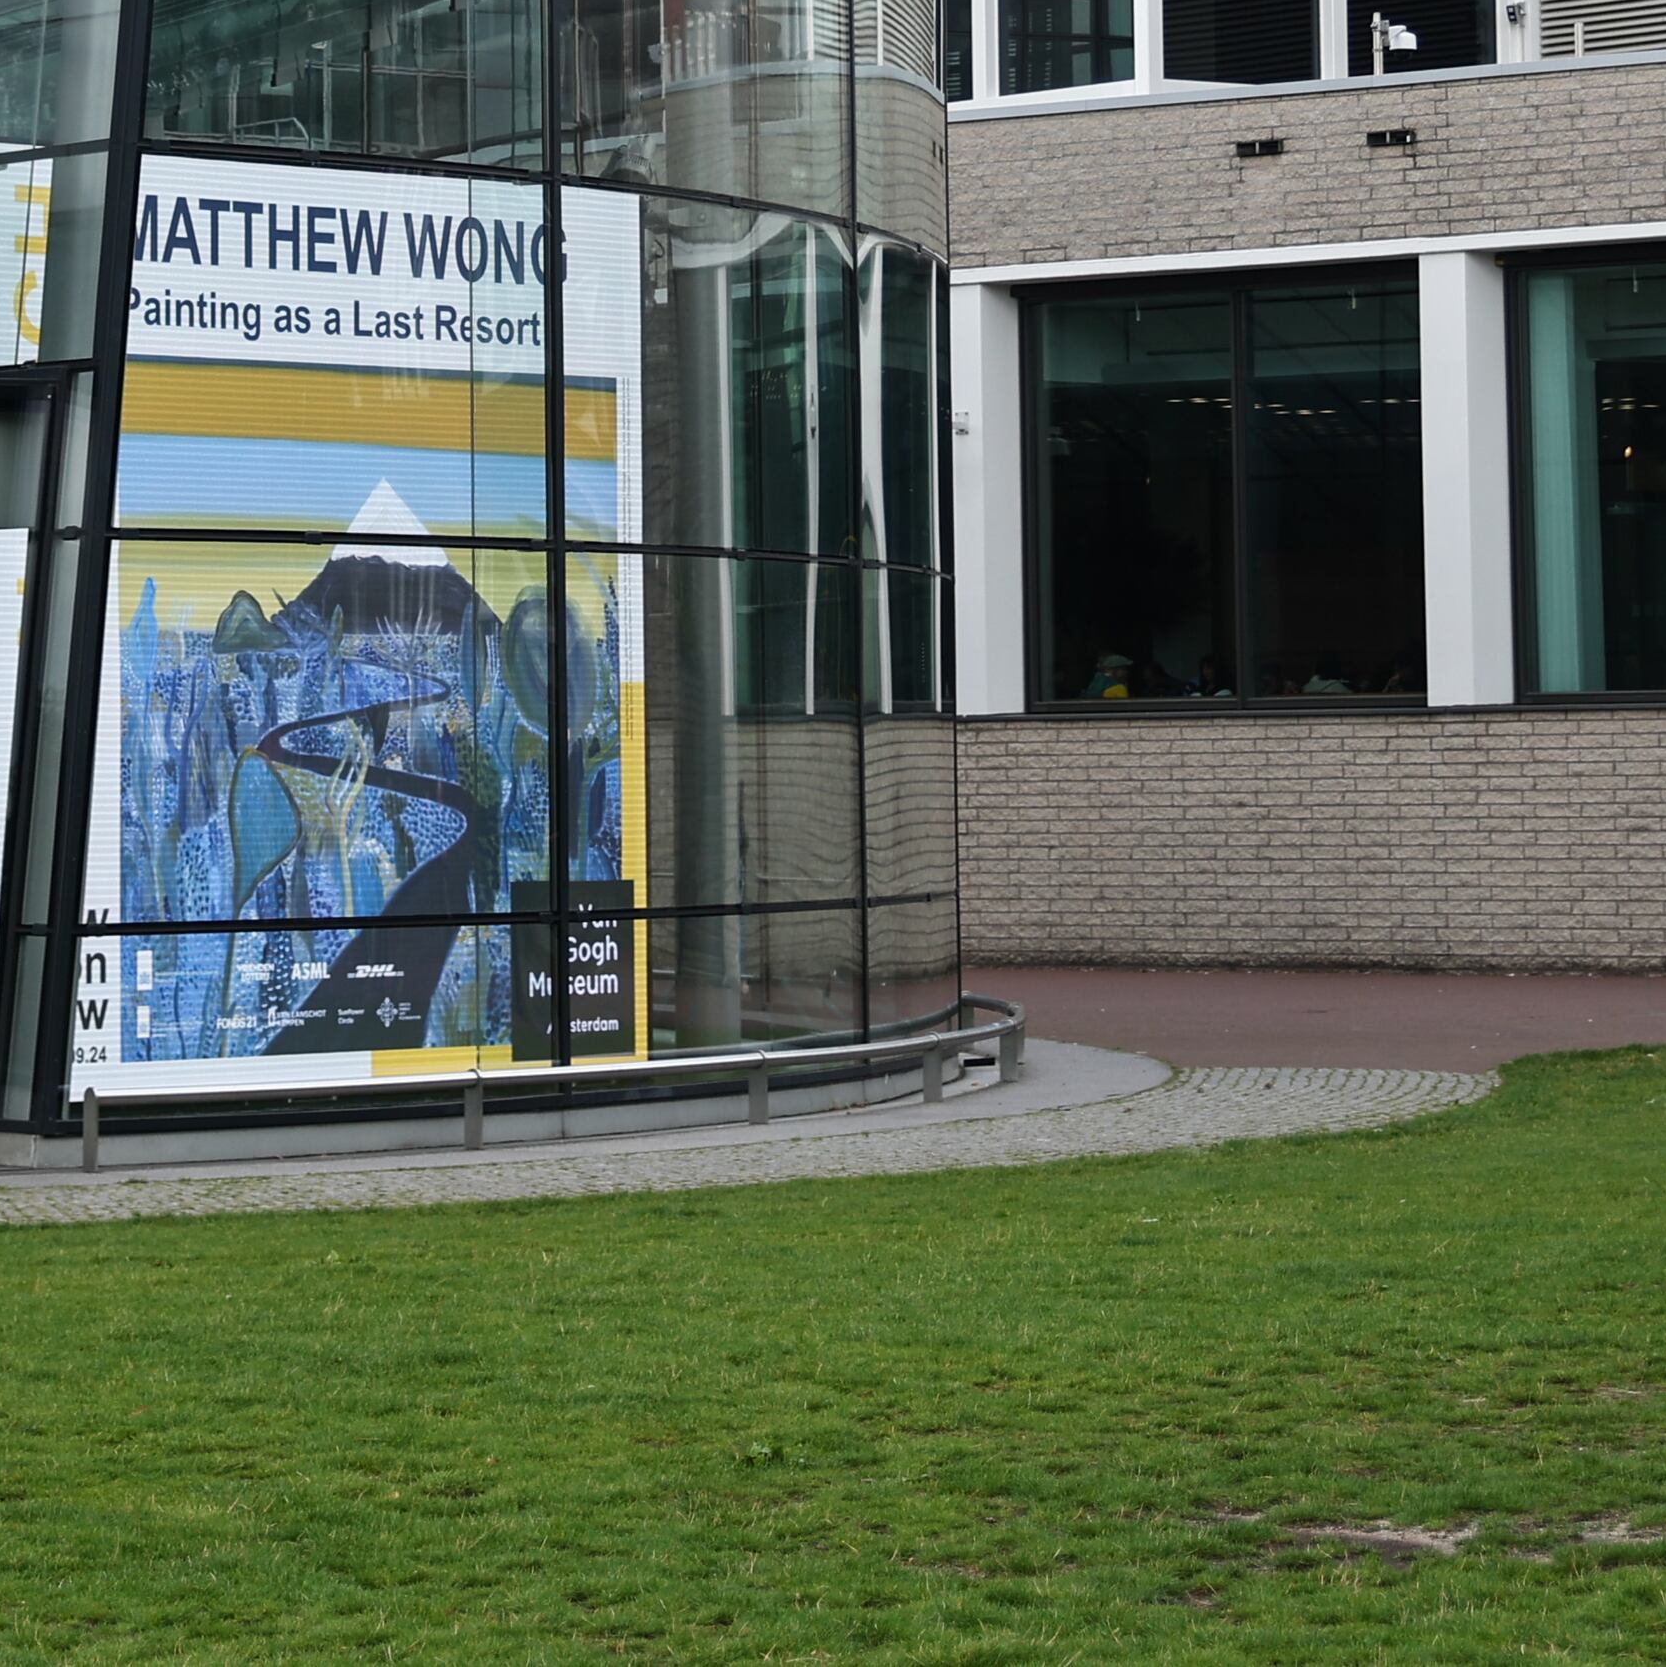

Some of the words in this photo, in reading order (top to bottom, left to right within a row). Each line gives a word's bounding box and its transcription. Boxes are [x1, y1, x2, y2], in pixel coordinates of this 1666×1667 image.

[134, 194, 389, 276] MATTHEW
[404, 212, 568, 285] WONG
[273, 304, 311, 334] as
[323, 307, 341, 336] a
[354, 300, 424, 340] Last
[435, 304, 541, 346] Resort
[290, 961, 331, 980] ASML
[355, 963, 396, 978] DHL
[546, 1016, 620, 1035] sterdam
[72, 1046, 108, 1065] 9.24
